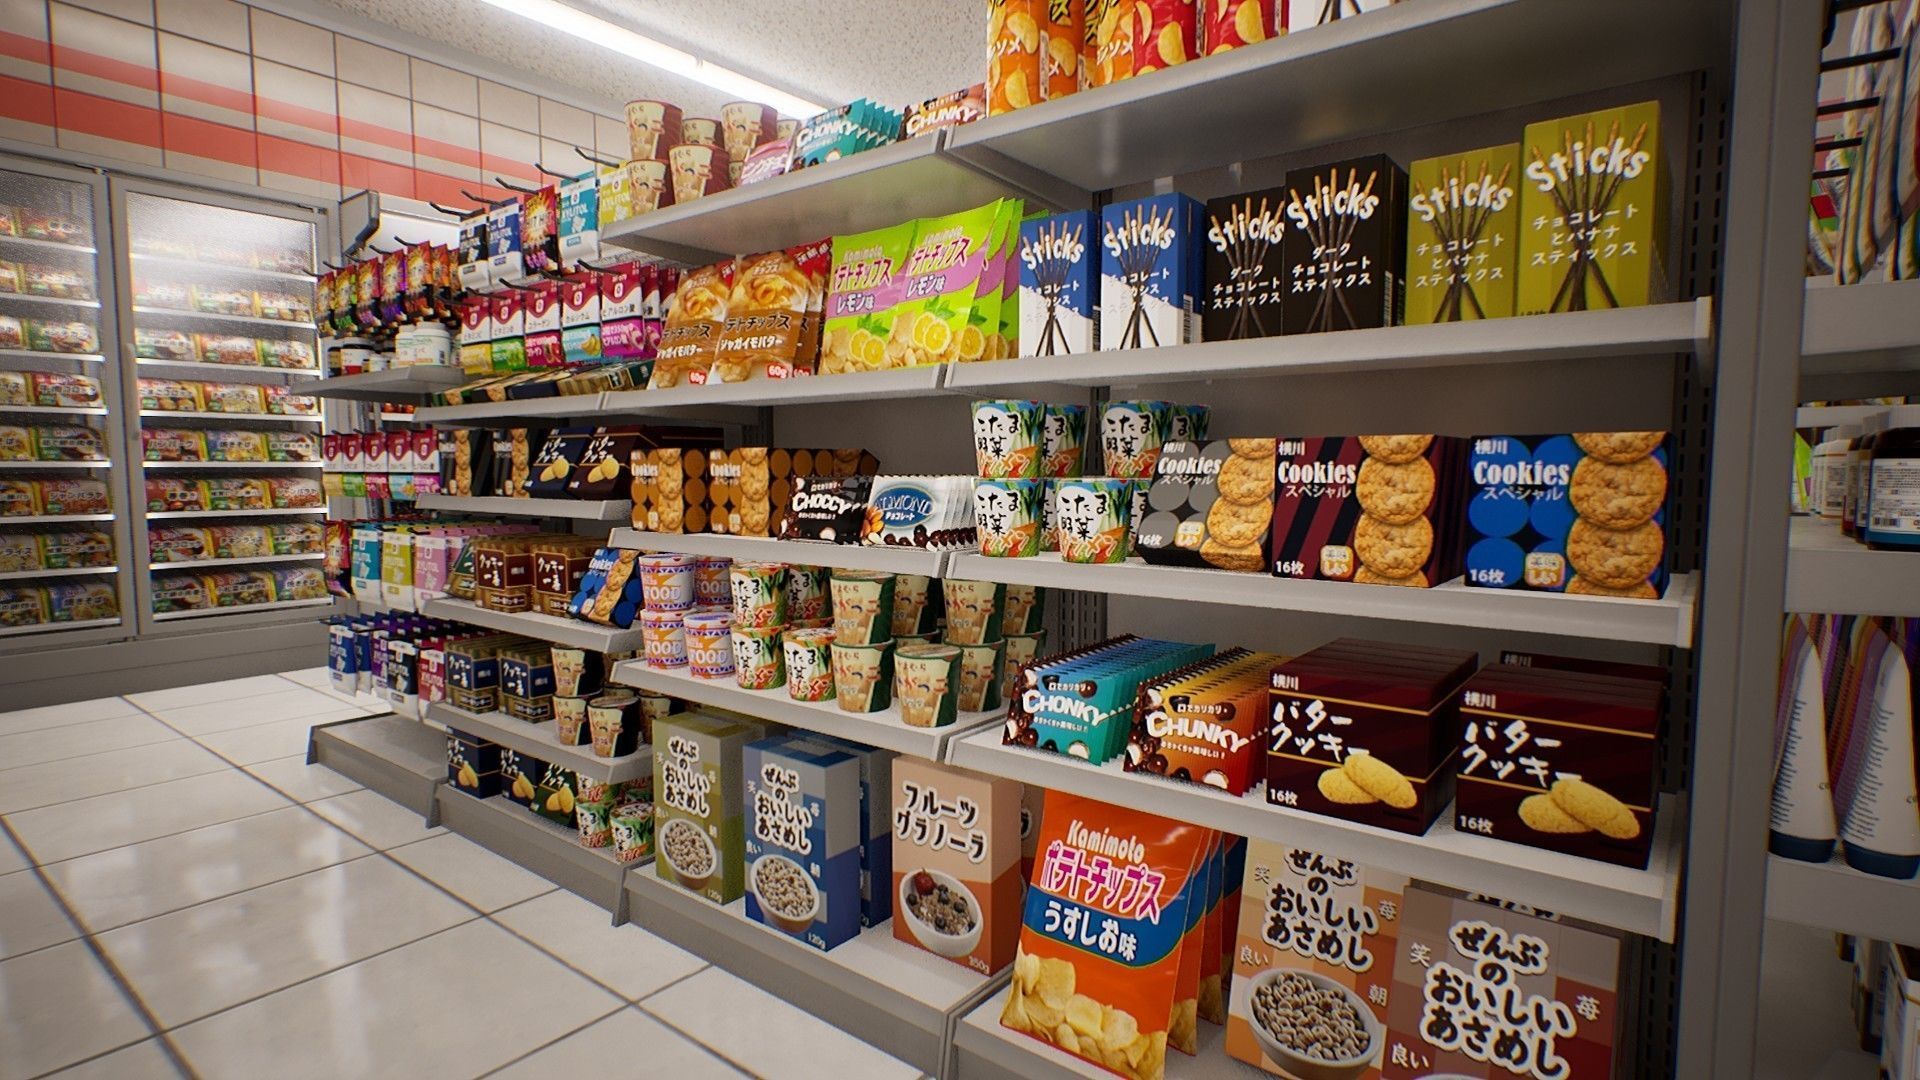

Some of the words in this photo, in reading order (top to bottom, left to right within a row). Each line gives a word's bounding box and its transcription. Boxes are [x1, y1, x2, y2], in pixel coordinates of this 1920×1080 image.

[905, 105, 978, 135] CHUNKY
[796, 120, 860, 149] CHONKY
[1526, 136, 1649, 192] Sticks
[1287, 182, 1380, 230] Sticks
[1411, 174, 1514, 222] Sticks
[1533, 204, 1639, 231] チョコレート
[1104, 217, 1176, 257] Sticks
[1208, 210, 1285, 252] Sticks
[1551, 225, 1620, 246] とバナナ
[1021, 233, 1085, 270] Sticks
[1312, 243, 1351, 260] ダーク
[1416, 233, 1505, 256] チョコレート
[1531, 241, 1638, 267] スティックス
[905, 237, 973, 277] テトチップス
[1292, 256, 1372, 278] チョコレート
[1432, 252, 1489, 271] とバナナ
[833, 257, 894, 293] テトチップス
[1230, 265, 1264, 280] ダーク
[1291, 272, 1372, 293] スティックス
[1416, 267, 1504, 288] スティックス
[906, 273, 947, 298] レモン味
[1212, 276, 1281, 296] チョコレート
[836, 292, 876, 315] レモン味
[1212, 292, 1281, 310] スティックス
[662, 323, 713, 339] テトチップス
[724, 313, 792, 333] テトチップス
[656, 344, 704, 360] ャガイモバター
[767, 364, 789, 380] 60g
[1278, 441, 1306, 456] 横川
[1474, 439, 1509, 455] 横川
[631, 463, 660, 477] Cookies
[710, 463, 742, 477] Cookies
[1157, 457, 1223, 475] Cookies
[1277, 460, 1357, 484] Cookies
[1473, 460, 1570, 485] Cookies
[1160, 474, 1215, 486] スペシャル
[1285, 484, 1352, 499] スペシャル
[791, 492, 851, 515] CHOCCY
[1483, 486, 1564, 501] スペシャル
[1138, 534, 1163, 546] 16枚
[538, 556, 565, 573] クッキー
[588, 557, 614, 571] Cookies
[1275, 560, 1304, 575] 16枚
[699, 579, 730, 595] OOD
[1469, 568, 1505, 584] 16枚
[1272, 673, 1300, 691] 横川
[1022, 689, 1110, 728] CHONKY
[1176, 703, 1223, 715] 口でカリカリ
[1464, 691, 1497, 709] 横川
[1273, 699, 1353, 732] バター
[1146, 710, 1250, 754] CHUNKY
[1271, 722, 1371, 763] クッキー
[1463, 719, 1563, 754] バター
[670, 738, 698, 759] ぜんぶ
[679, 757, 689, 770] の
[1462, 744, 1583, 788] クッキー
[665, 764, 709, 792] おいしい
[763, 767, 798, 789] ぜんぶ
[664, 784, 709, 816] あさめし
[774, 787, 786, 801] の
[904, 784, 977, 826] フルーツ
[1270, 788, 1298, 806] 16枚
[757, 794, 812, 827] おいしい
[757, 817, 810, 851] あさめし
[896, 810, 985, 860] グラノーラ
[1459, 815, 1494, 834] 16枚
[1067, 818, 1145, 865] Kamimoto
[1286, 848, 1358, 881] ぜんぶ
[1040, 840, 1166, 925] ポテトチップス
[1307, 876, 1329, 896] の
[1269, 882, 1375, 932] おいしい
[807, 931, 826, 950] 120g
[1044, 900, 1138, 962] うすしお味
[1266, 912, 1369, 967] あさめし
[1240, 945, 1269, 966] 良い
[1410, 942, 1431, 968] 笑
[1455, 925, 1543, 968] ぜんぶ
[1480, 962, 1508, 986] の
[1430, 967, 1570, 1034] おいしい
[1426, 1004, 1564, 1077] あさめし
[1392, 1042, 1430, 1069] 良い
